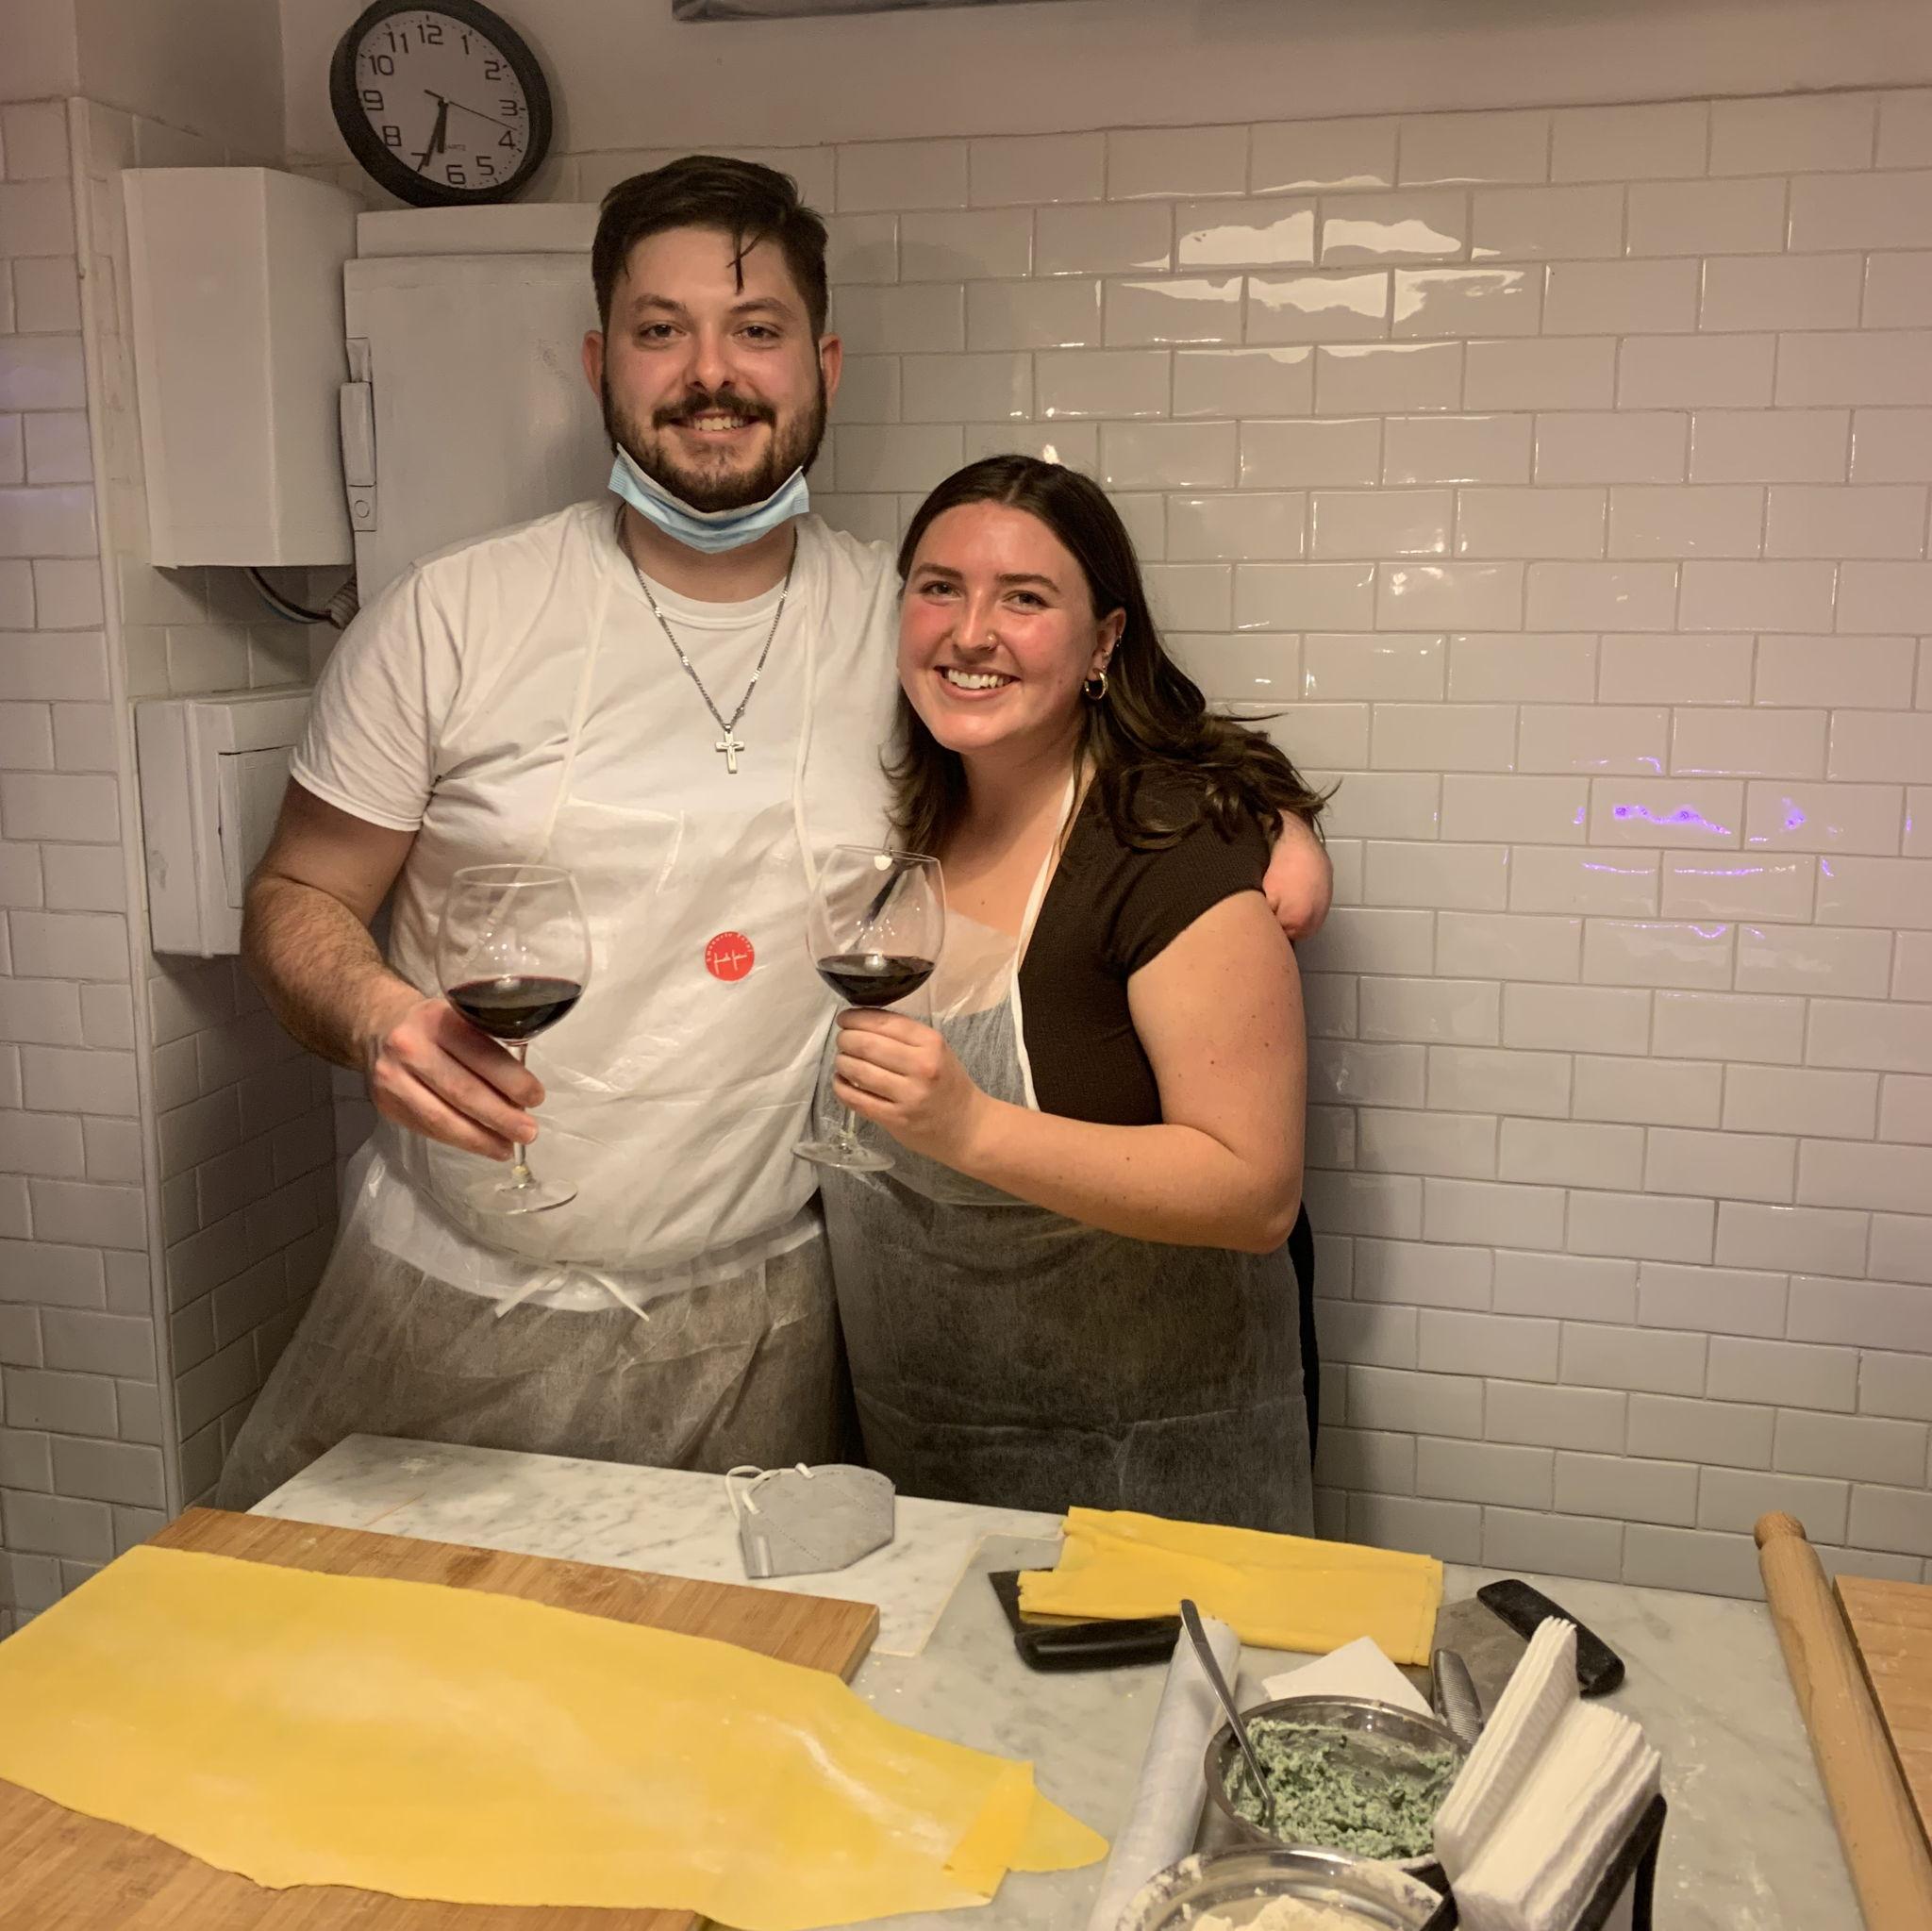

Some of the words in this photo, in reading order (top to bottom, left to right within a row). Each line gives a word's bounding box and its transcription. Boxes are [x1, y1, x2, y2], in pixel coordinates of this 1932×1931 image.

[385, 30, 408, 54] 11
[417, 24, 443, 45] 12
[460, 34, 470, 55] 1
[369, 55, 394, 75] 10
[484, 60, 501, 80] 2
[363, 90, 384, 111] 9
[499, 99, 518, 116] 3
[382, 125, 402, 147] 8
[498, 130, 516, 150] 4
[410, 152, 427, 173] 7
[475, 156, 495, 175] 5
[445, 164, 466, 185] 6
